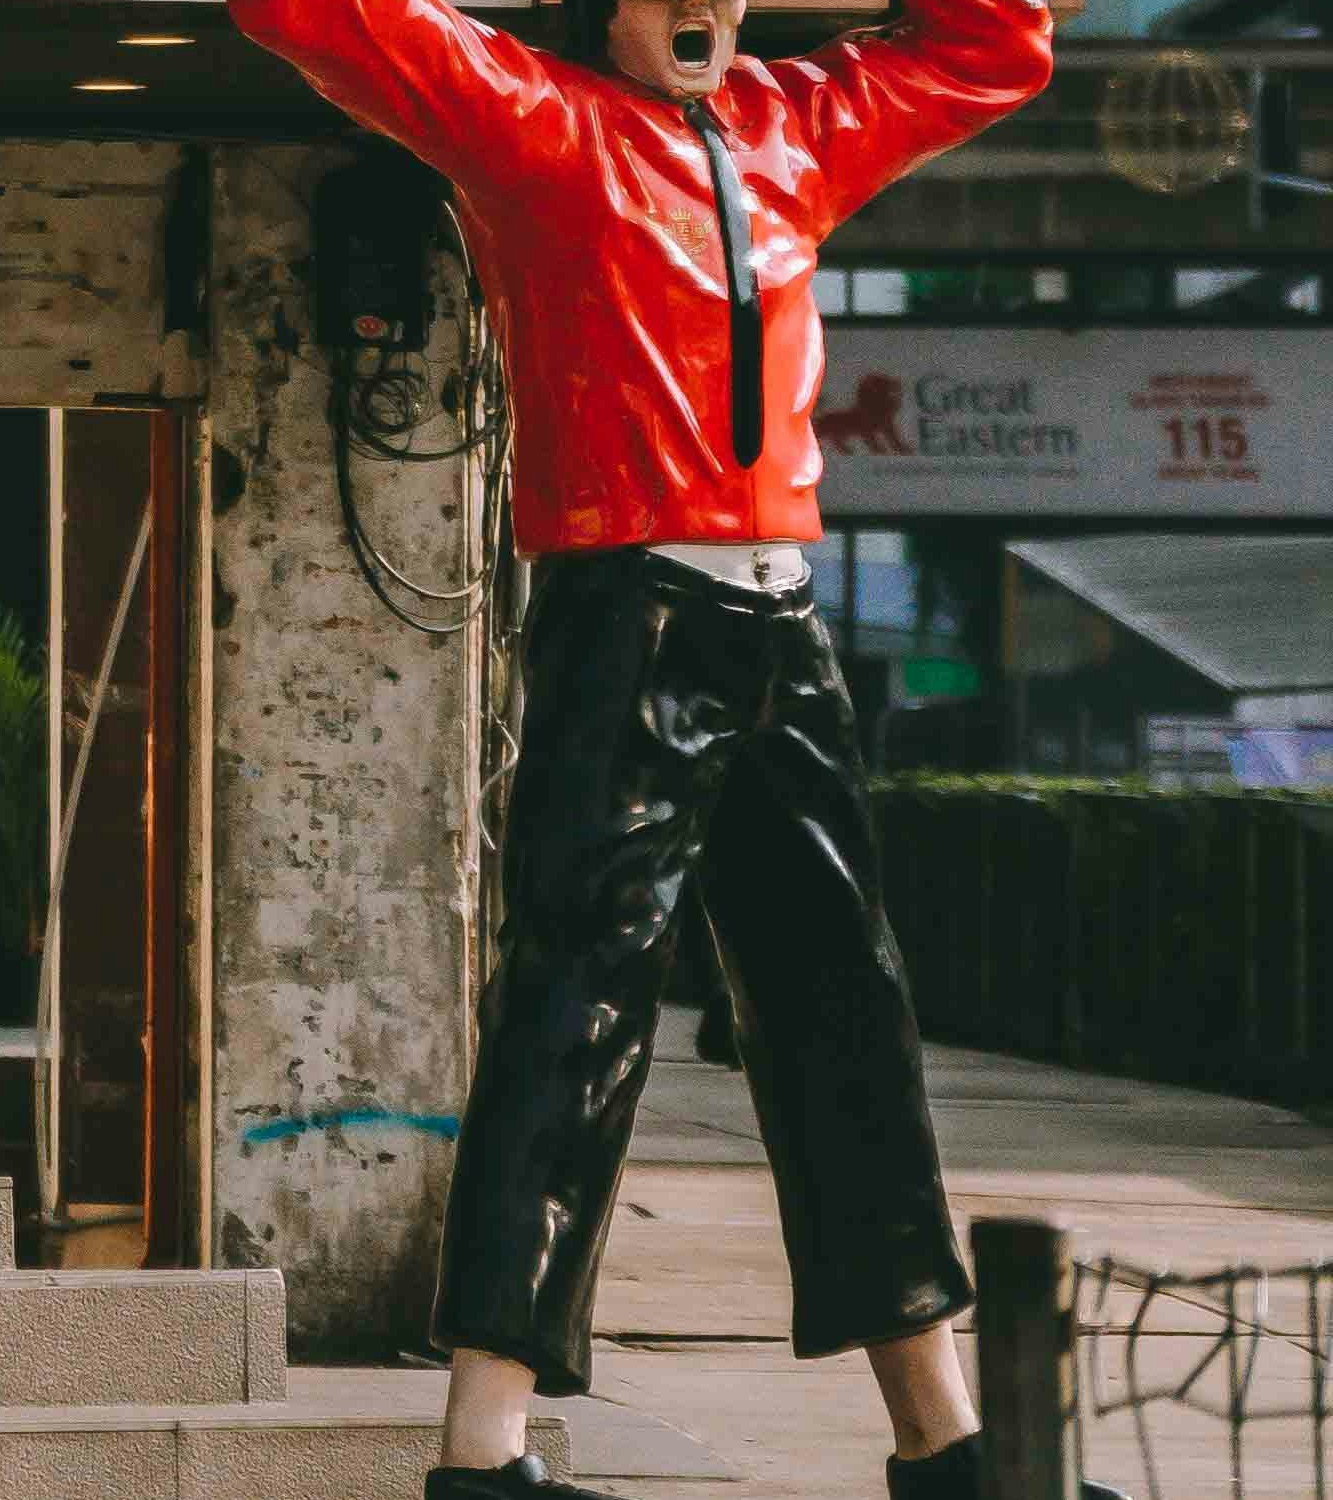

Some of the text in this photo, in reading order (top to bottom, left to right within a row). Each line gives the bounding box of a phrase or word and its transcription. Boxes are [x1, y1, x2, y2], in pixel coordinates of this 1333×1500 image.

[914, 374, 1035, 415] Great
[917, 418, 1078, 458] Eastern
[1163, 416, 1248, 460] 115
